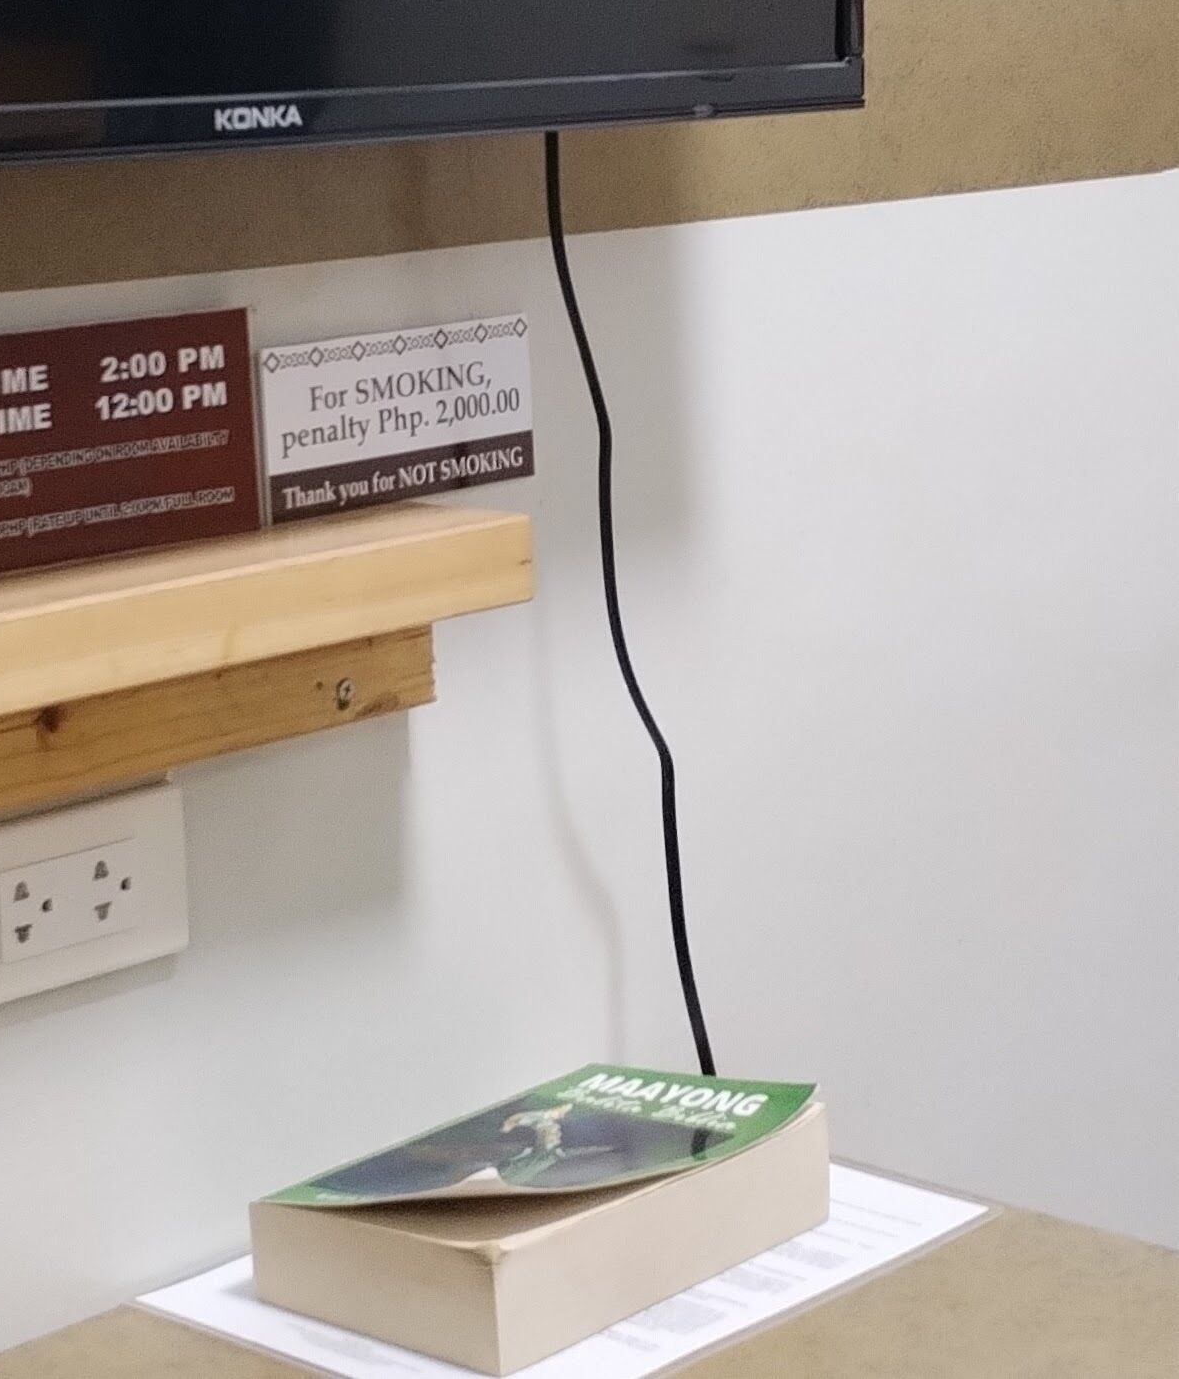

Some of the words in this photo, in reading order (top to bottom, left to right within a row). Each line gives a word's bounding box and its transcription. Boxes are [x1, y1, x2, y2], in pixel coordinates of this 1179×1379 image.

[214, 104, 303, 131] KONKA
[100, 350, 167, 383] 2:00
[177, 344, 226, 373] PM
[94, 387, 174, 421] 12:00
[182, 381, 228, 410] PM
[308, 385, 348, 412] For
[355, 361, 491, 405] SMOKING,
[281, 414, 370, 459] penalty
[378, 405, 429, 437] Php.
[435, 387, 520, 428] 2,000.00
[282, 481, 336, 510] Thank
[340, 481, 369, 505] you
[372, 471, 396, 493] for
[398, 462, 437, 489] NOT
[440, 447, 523, 480] SMOKING
[577, 1073, 769, 1117] MAAYONG
